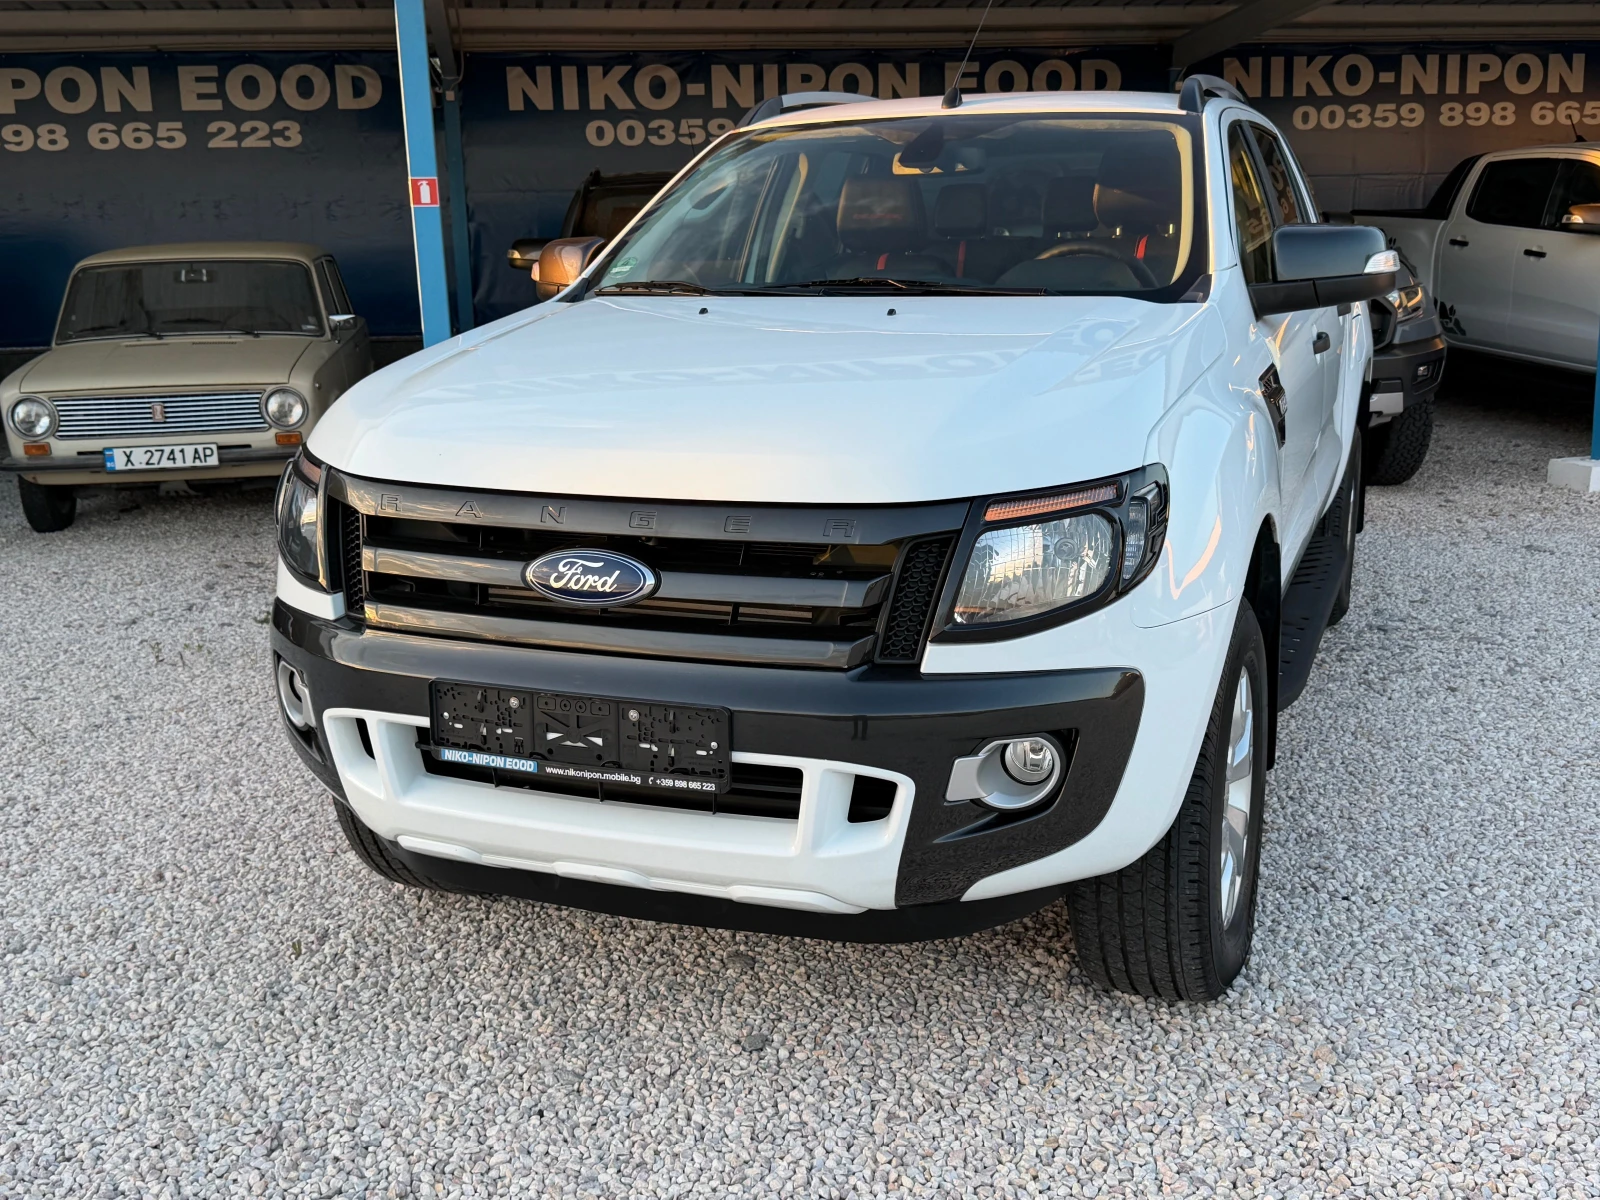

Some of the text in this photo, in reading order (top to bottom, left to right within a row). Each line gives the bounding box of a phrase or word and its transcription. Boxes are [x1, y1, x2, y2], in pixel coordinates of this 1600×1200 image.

[177, 63, 383, 112] EOOD
[506, 62, 920, 111] NIKO-NIPON
[1223, 53, 1586, 98] NIKO-NIPON
[1292, 100, 1600, 131] 00359 898 665
[1, 120, 303, 151] 98 665 223
[380, 493, 857, 538] RANGER
[549, 558, 621, 593] Ford
[444, 749, 535, 772] NIKO-NIPON EOOD
[545, 766, 641, 784] www.nikonipon.mobile.bg
